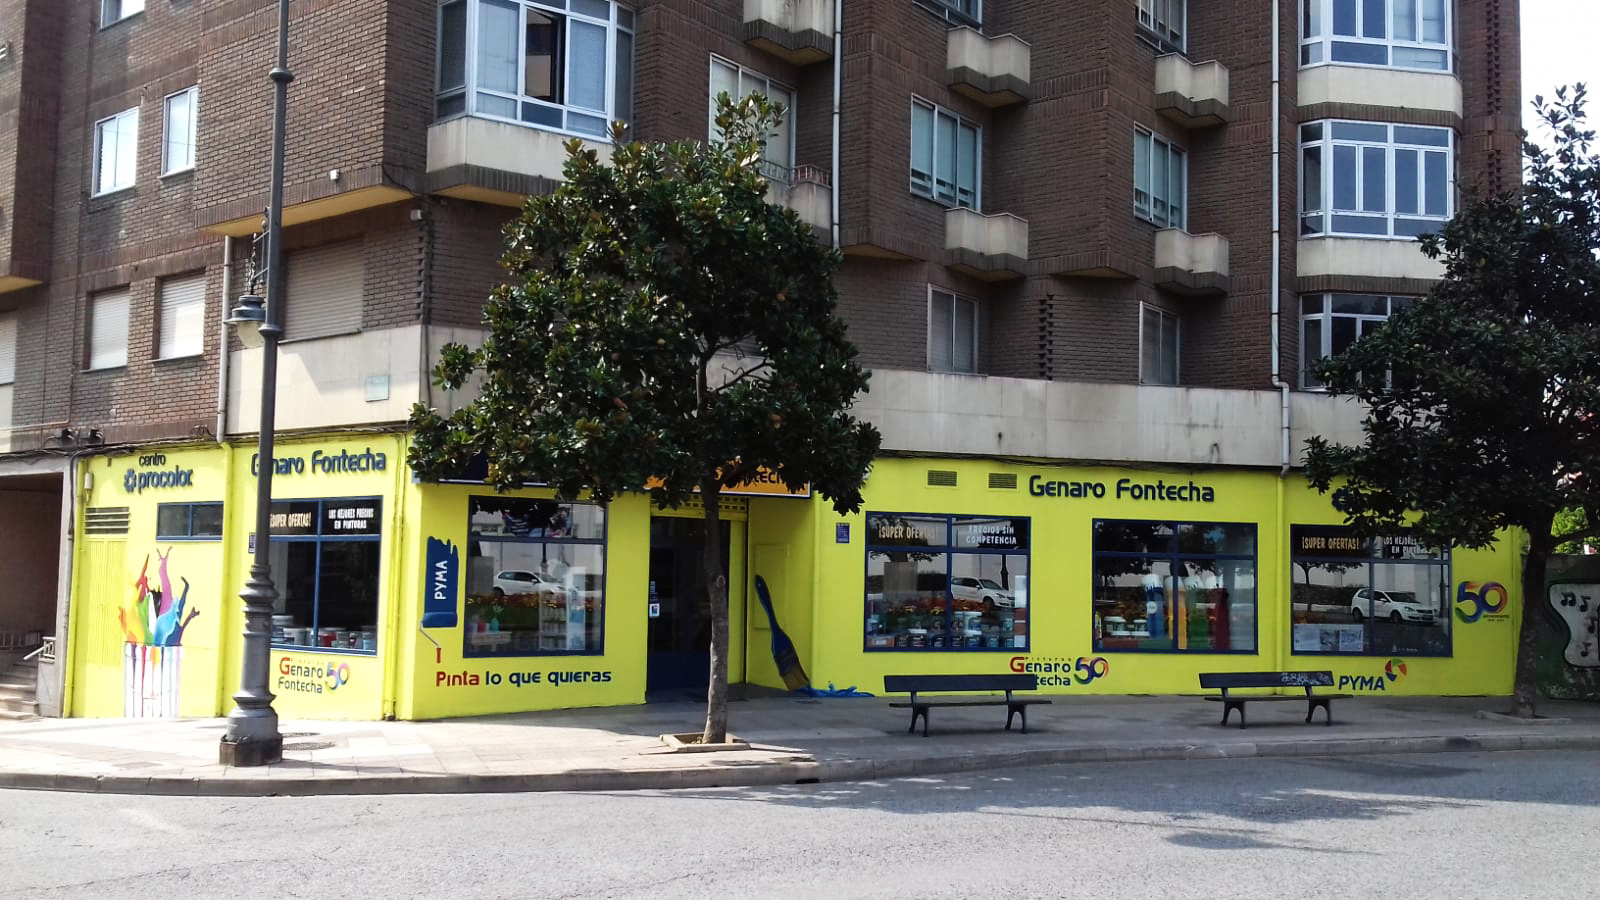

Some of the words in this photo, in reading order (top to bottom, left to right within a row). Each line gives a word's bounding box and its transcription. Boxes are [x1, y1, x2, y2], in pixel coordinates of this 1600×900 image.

[138, 452, 166, 467] centro
[251, 451, 305, 476] Gnaro
[311, 446, 387, 474] Fontecha
[138, 464, 194, 495] procolor
[1029, 474, 1106, 499] Genaro
[1116, 478, 1215, 503] Fontecha
[966, 535, 1017, 545] COMPETENCIA
[1302, 536, 1326, 549] ¡SUPER
[1327, 537, 1360, 550] OFERTAS!
[434, 560, 449, 600] PYMA
[1455, 581, 1508, 624] 50
[279, 657, 324, 679] Genaro
[436, 670, 480, 687] Pinta
[485, 670, 502, 685] lo
[508, 671, 541, 688] que
[547, 671, 612, 687] quieras
[1010, 656, 1071, 673] Genaro
[1074, 657, 1109, 685] 50
[277, 676, 323, 694] Fontecha
[1338, 675, 1386, 691] PYMA
